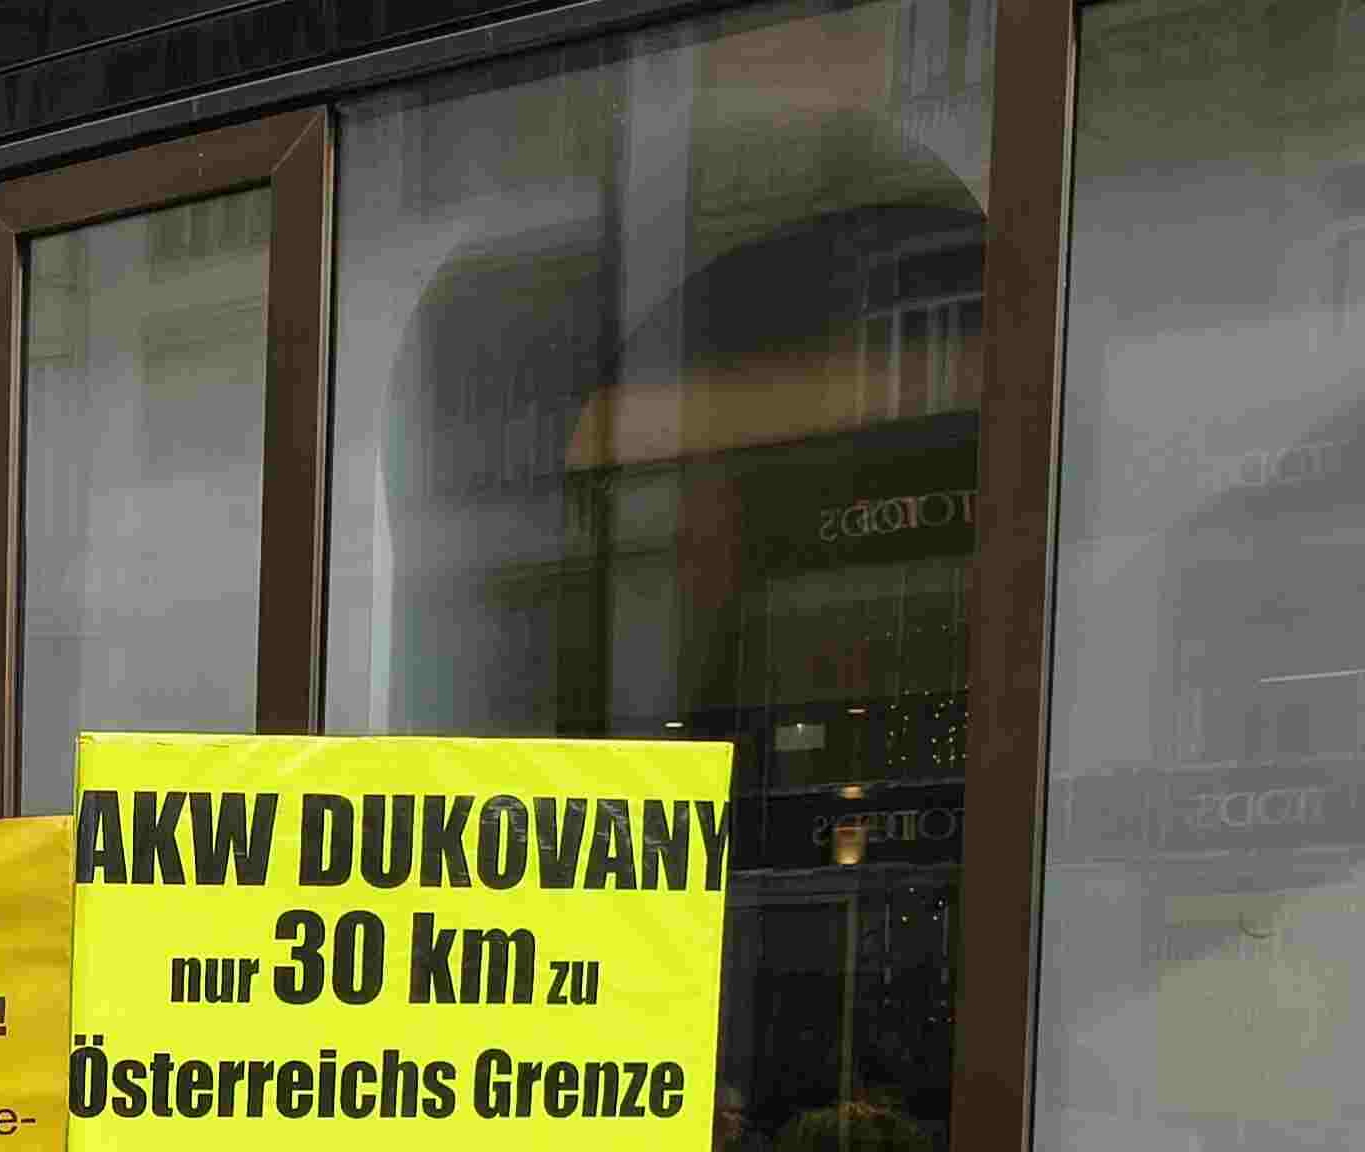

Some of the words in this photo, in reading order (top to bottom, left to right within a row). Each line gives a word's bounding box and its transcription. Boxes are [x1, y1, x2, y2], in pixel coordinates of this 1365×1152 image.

[75, 789, 279, 885] AKW
[298, 792, 732, 892] DUKOVANY
[169, 957, 260, 1004] nur
[273, 909, 384, 1005] 30
[408, 911, 536, 1005] km
[548, 959, 600, 1005] zu
[69, 1034, 456, 1118] Österreichs
[474, 1048, 684, 1118] Grenze
